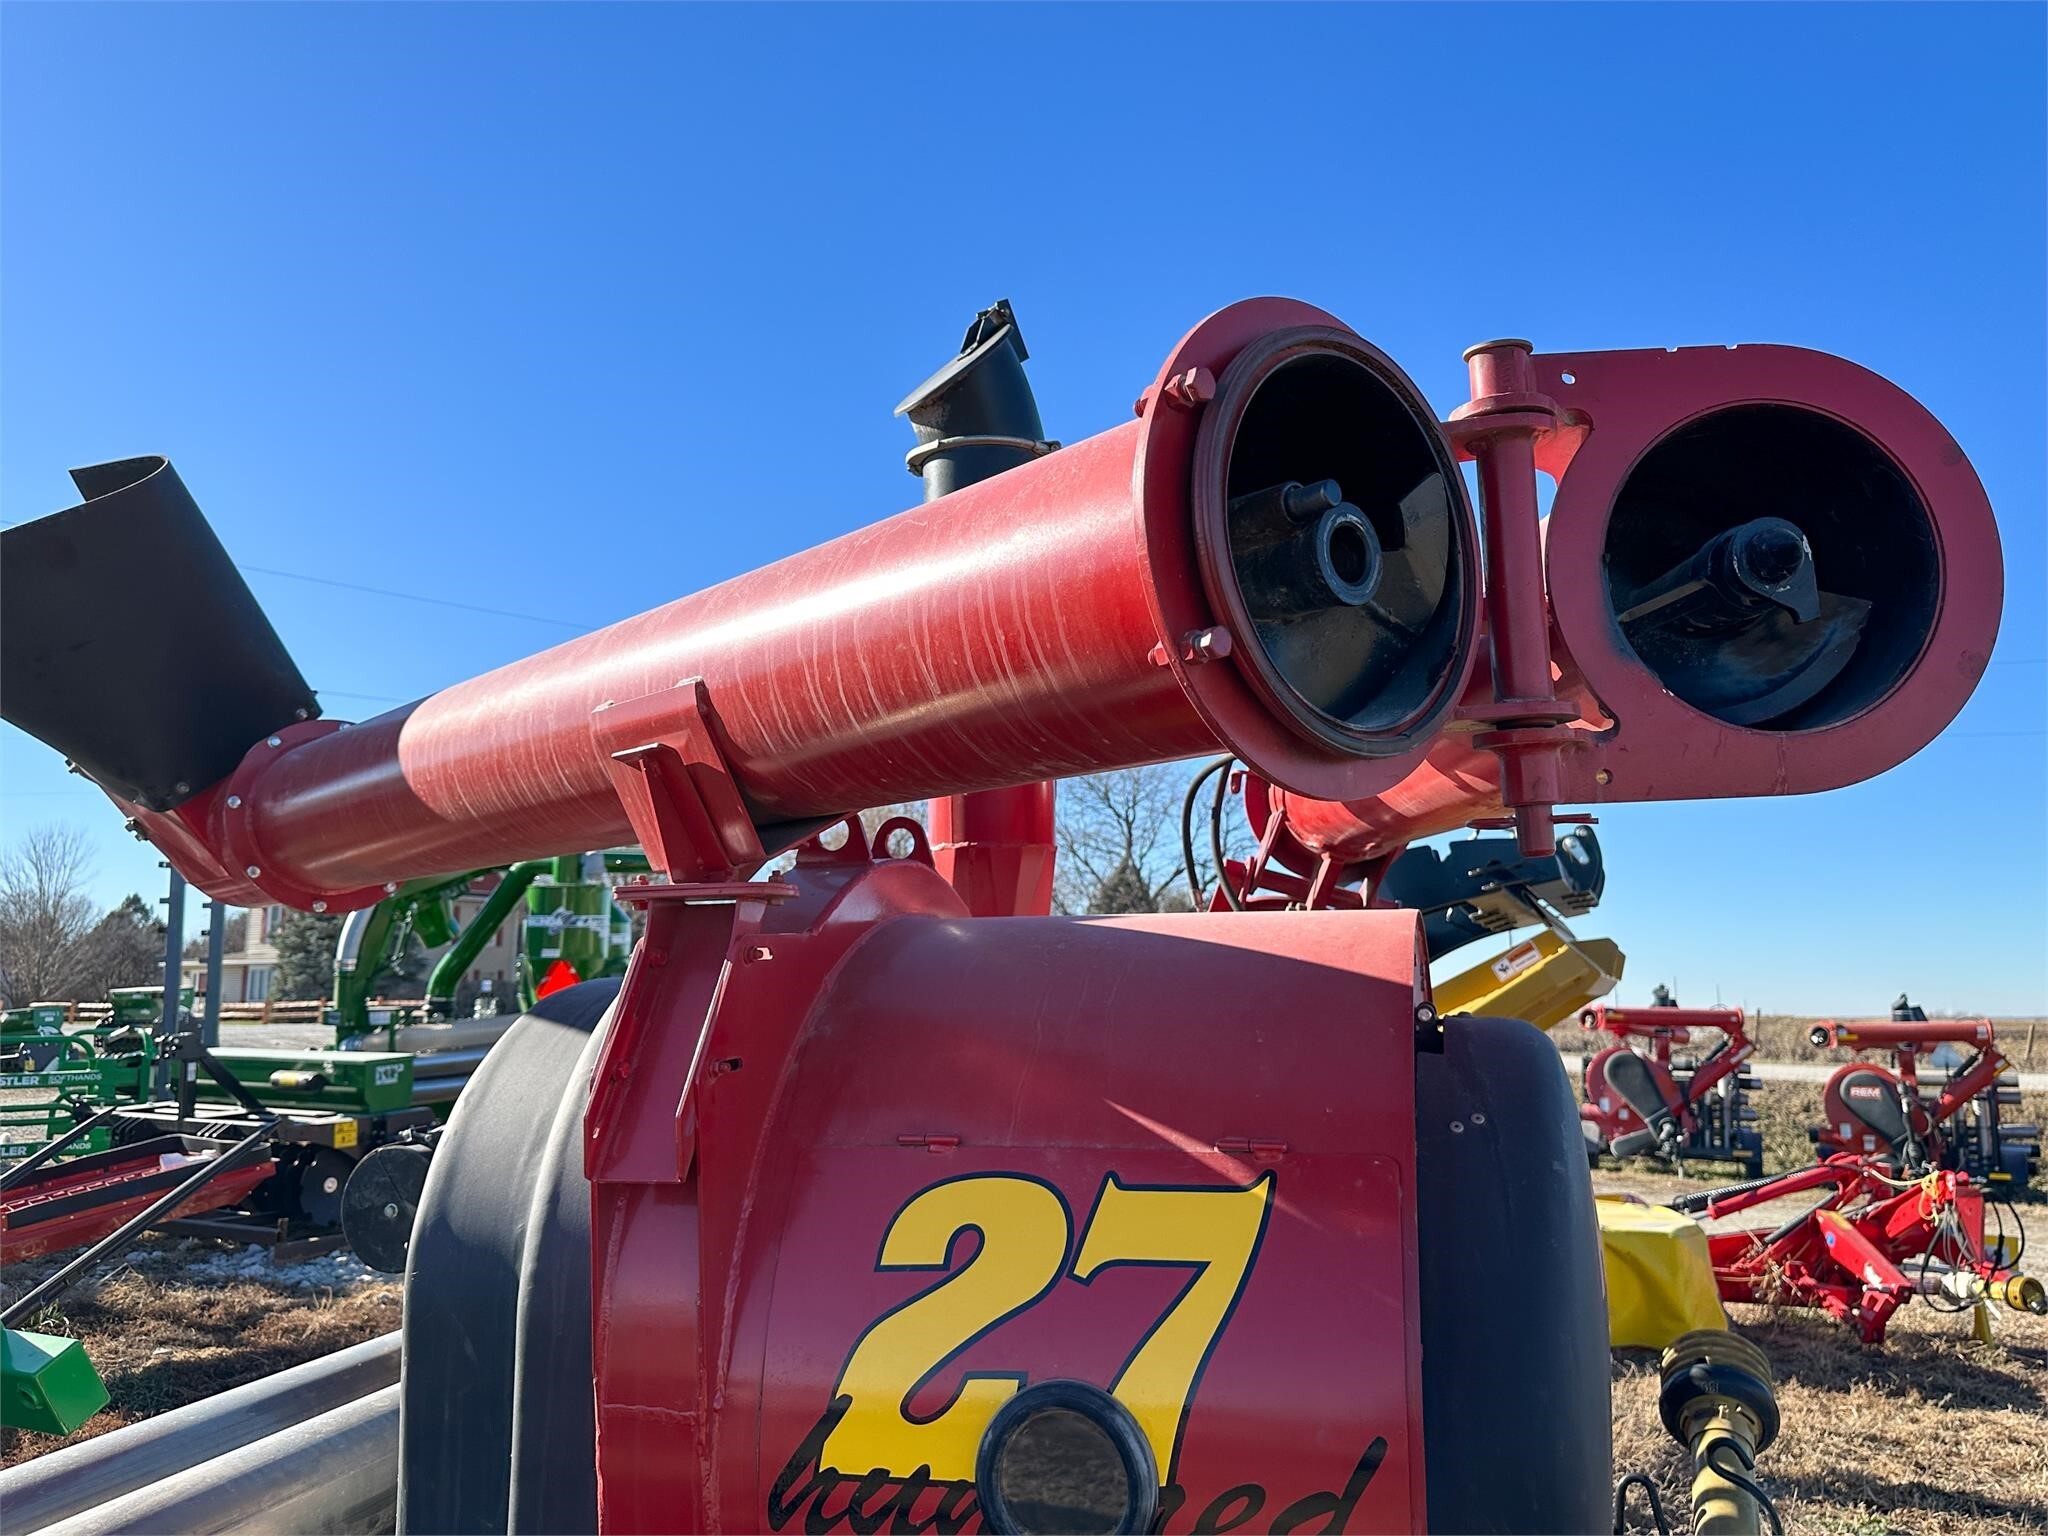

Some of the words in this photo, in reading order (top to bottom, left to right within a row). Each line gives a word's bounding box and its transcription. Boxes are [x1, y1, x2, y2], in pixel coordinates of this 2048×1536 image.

[48, 1073, 102, 1081] SOFTHANDS
[1850, 1087, 1881, 1097] REM
[0, 1146, 27, 1156] LER
[818, 1169, 1277, 1487] 27
